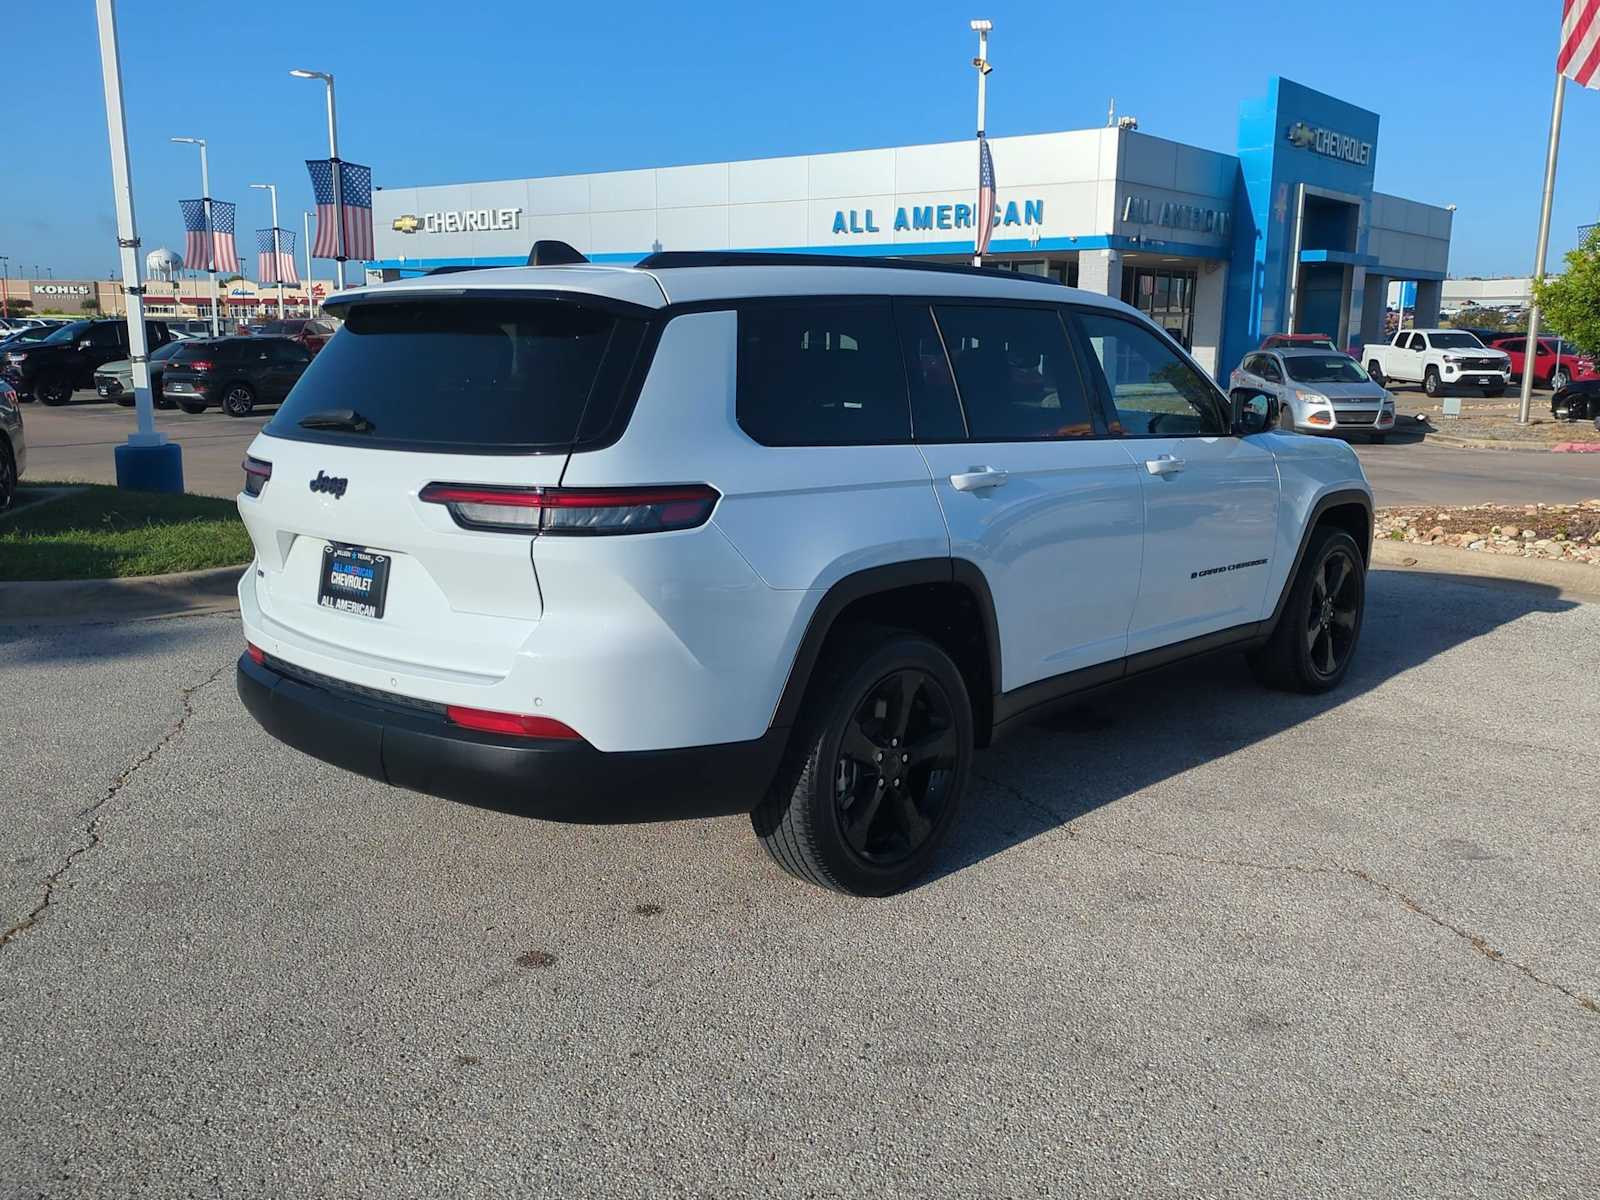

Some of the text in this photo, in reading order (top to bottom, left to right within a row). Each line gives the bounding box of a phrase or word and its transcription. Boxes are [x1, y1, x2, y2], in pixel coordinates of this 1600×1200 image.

[1315, 127, 1372, 166] CHEVROLET
[424, 208, 522, 233] CHEVROLET
[832, 209, 880, 234] ALL
[33, 285, 90, 295] KOHL'S
[331, 572, 372, 591] CHEVROLET
[321, 596, 376, 616] ALL AMERICAN
